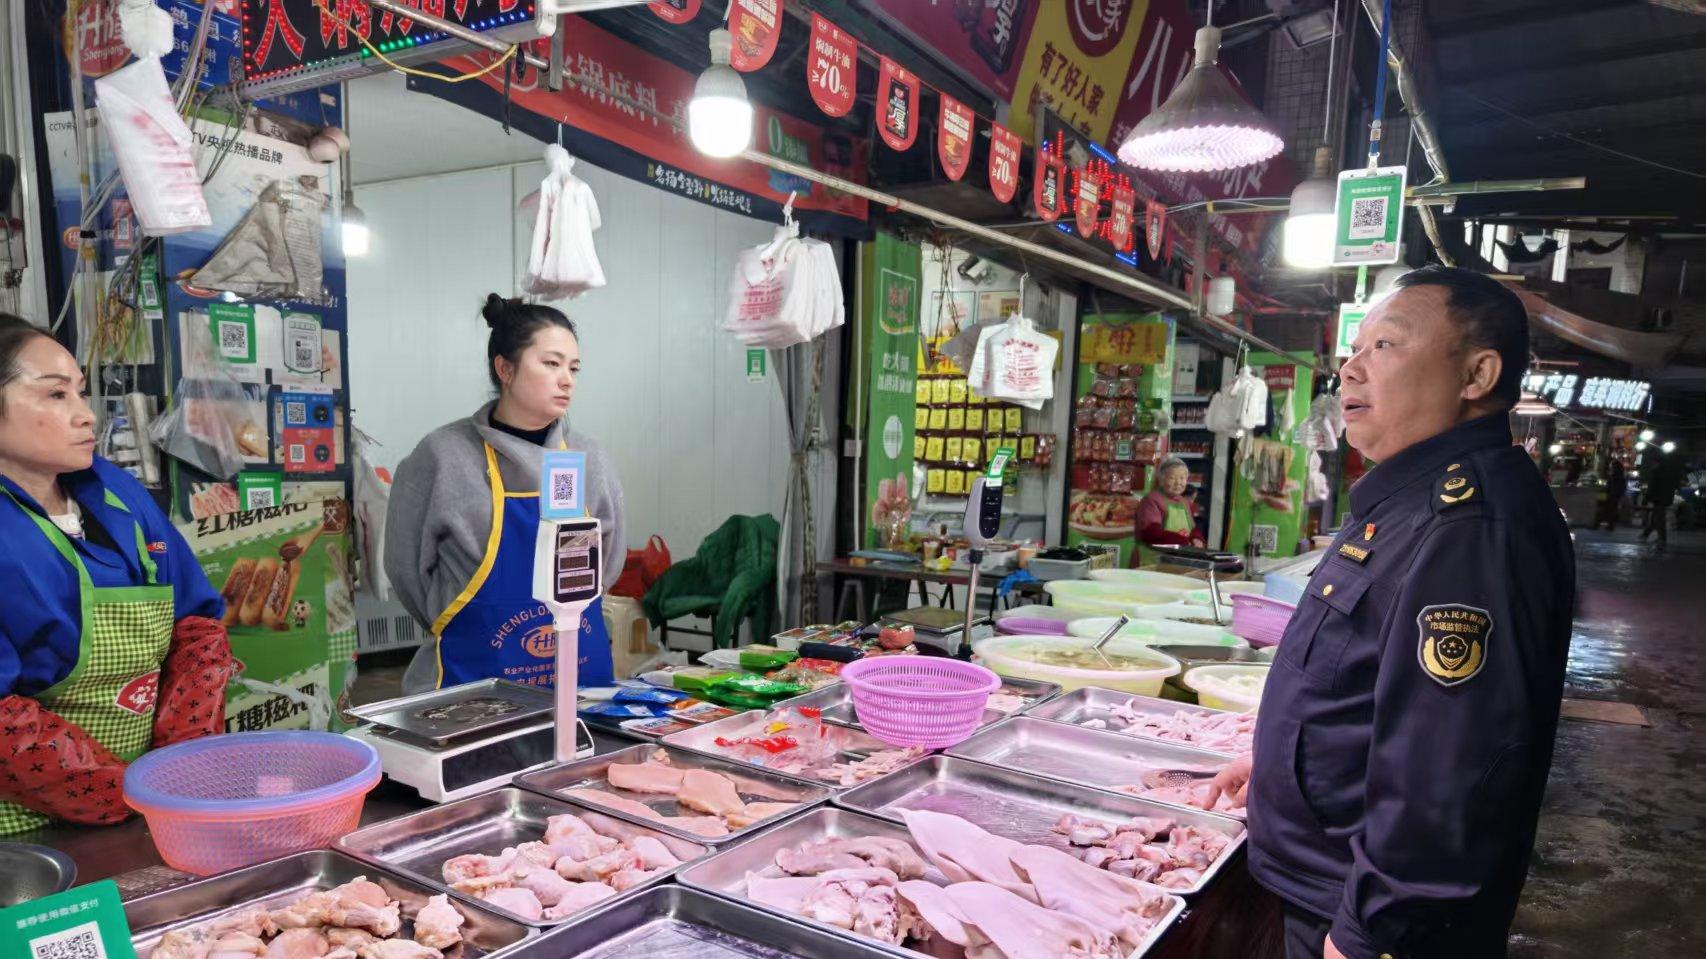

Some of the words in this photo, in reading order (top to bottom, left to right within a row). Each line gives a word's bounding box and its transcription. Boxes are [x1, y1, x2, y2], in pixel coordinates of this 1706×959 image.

[491, 605, 554, 649] SHENGLO
[1425, 611, 1487, 626] 中华人民共和国
[1430, 621, 1481, 634] 市场监管执法
[16, 899, 99, 929] 推荐使用微信支付
